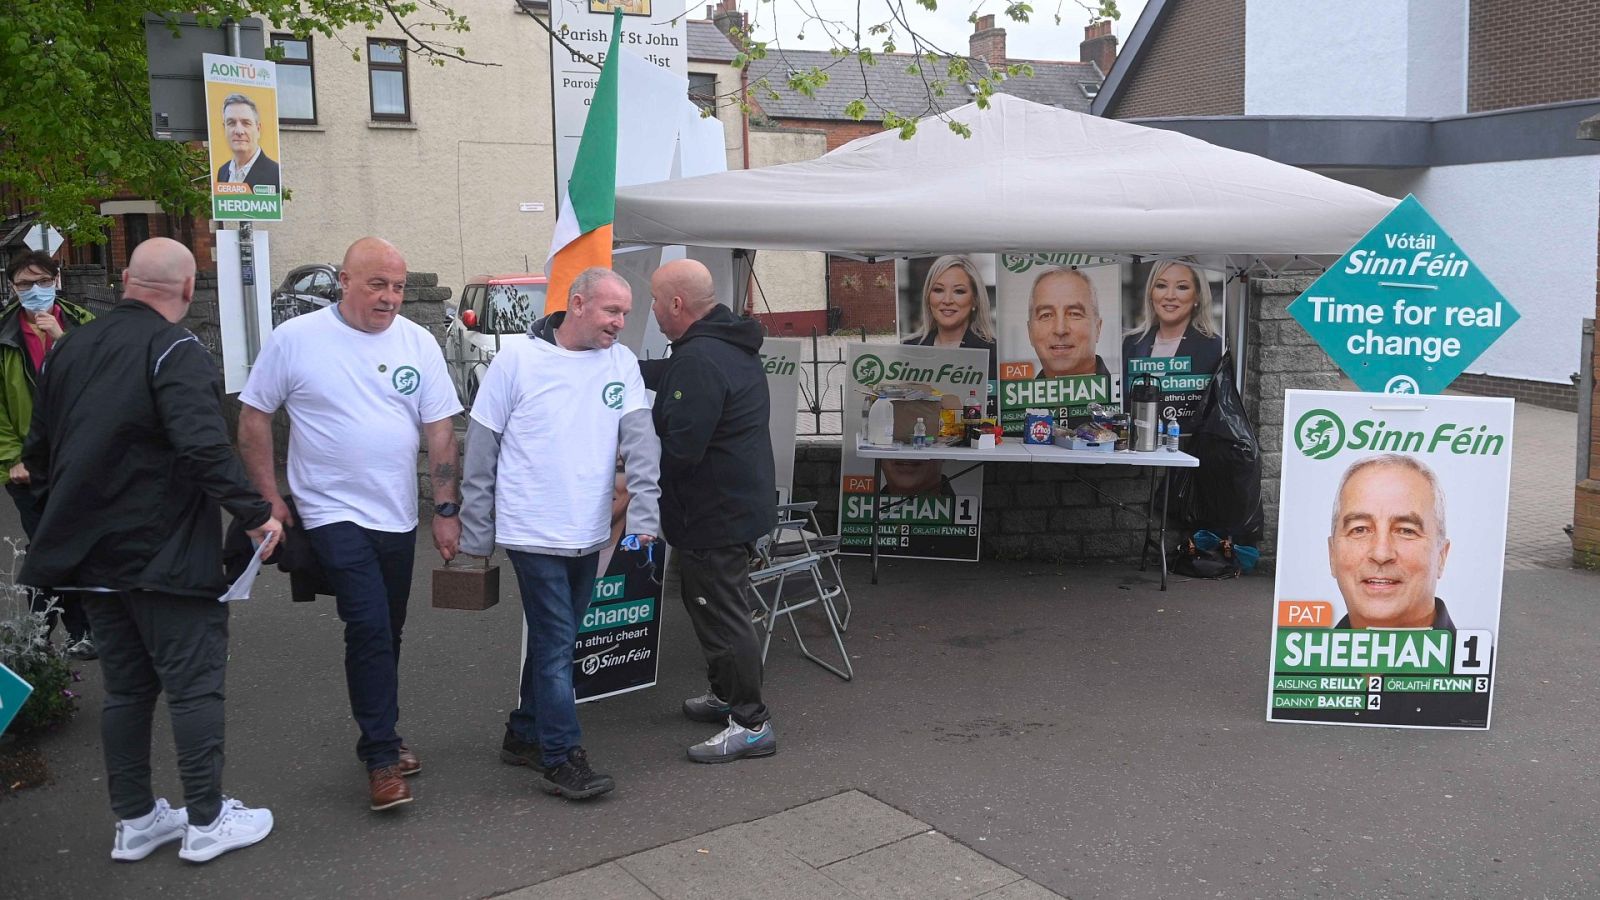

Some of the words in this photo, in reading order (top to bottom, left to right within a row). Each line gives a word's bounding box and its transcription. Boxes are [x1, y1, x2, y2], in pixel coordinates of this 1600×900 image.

[560, 29, 608, 42] Parish
[629, 32, 642, 44] St
[645, 33, 679, 46] John
[210, 63, 256, 79] AONTÚ
[563, 78, 599, 88] Parois
[217, 185, 247, 193] GERARD
[218, 199, 277, 212] HERDMAN
[1385, 233, 1436, 250] Vótáil
[1345, 250, 1406, 276] Sinn
[1408, 252, 1469, 277] Féin
[1308, 297, 1384, 324] Time
[1393, 299, 1437, 325] for
[1445, 302, 1502, 327] real
[1347, 329, 1461, 362] change
[760, 354, 796, 375] éin
[885, 361, 934, 382] Sinn
[936, 363, 984, 384] Féin
[1006, 365, 1029, 377] PAT
[1130, 360, 1165, 371] Time
[1169, 359, 1189, 370] for
[1005, 374, 1107, 405] SHEEHAN
[1165, 394, 1185, 402] athrú
[1347, 419, 1426, 451] Sinn
[1430, 423, 1505, 456] Féin
[849, 478, 873, 490] PAT
[959, 499, 972, 520] 1
[941, 527, 966, 535] FLYNN
[842, 537, 867, 545] DANNY
[595, 579, 623, 598] for
[583, 604, 650, 628] change
[1288, 606, 1325, 623] PAT
[585, 632, 613, 647] athrú
[616, 626, 648, 641] cheart
[599, 652, 626, 668] Sinn
[626, 646, 651, 663] Féin
[1283, 631, 1448, 668] SHEEHAN
[1461, 635, 1481, 668] 1
[1276, 680, 1317, 690] AISLING
[1320, 677, 1364, 690] REILLY
[1370, 678, 1380, 690] 2
[1433, 678, 1472, 691] FLYNN
[1477, 679, 1486, 690] 3
[1275, 698, 1315, 707] DANNY
[1317, 696, 1362, 708] BAKER
[1369, 697, 1379, 708] 4
